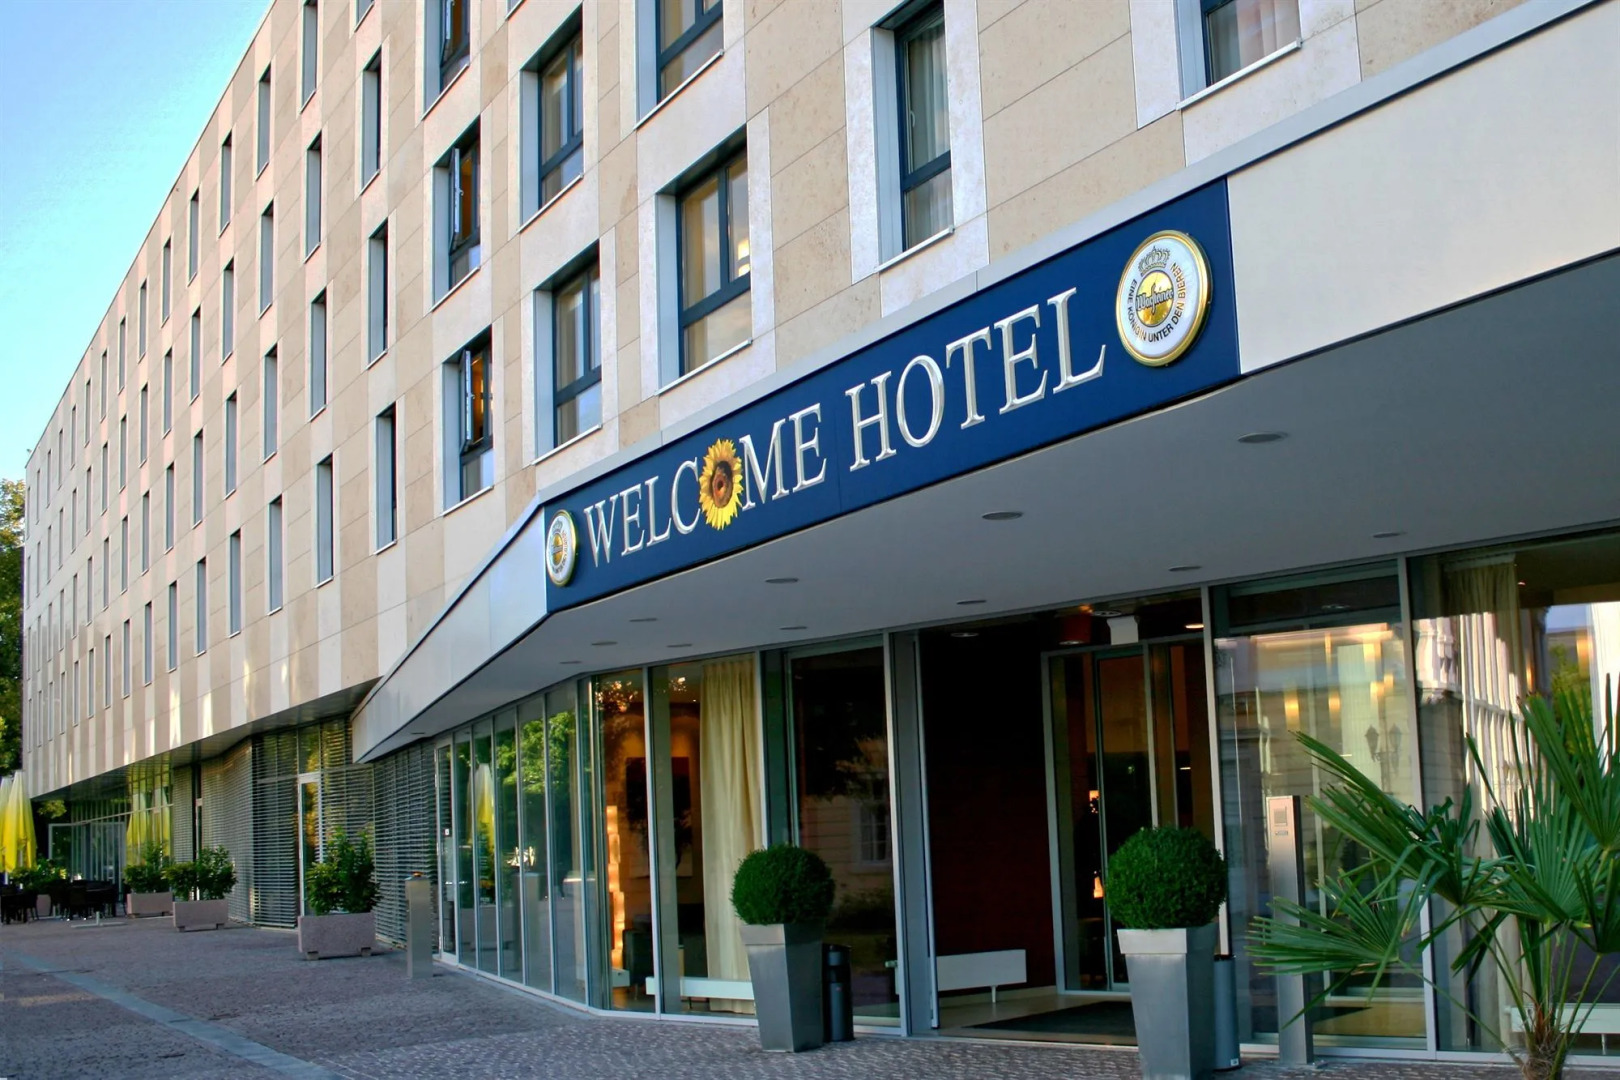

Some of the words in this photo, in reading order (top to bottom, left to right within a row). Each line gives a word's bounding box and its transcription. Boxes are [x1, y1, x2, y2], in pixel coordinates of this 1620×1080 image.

[1127, 279, 1138, 304] EINE
[1170, 262, 1186, 299] BIEREN
[1171, 303, 1185, 325] DEN
[1148, 323, 1174, 342] UNTER
[844, 286, 1106, 472] HOTEL
